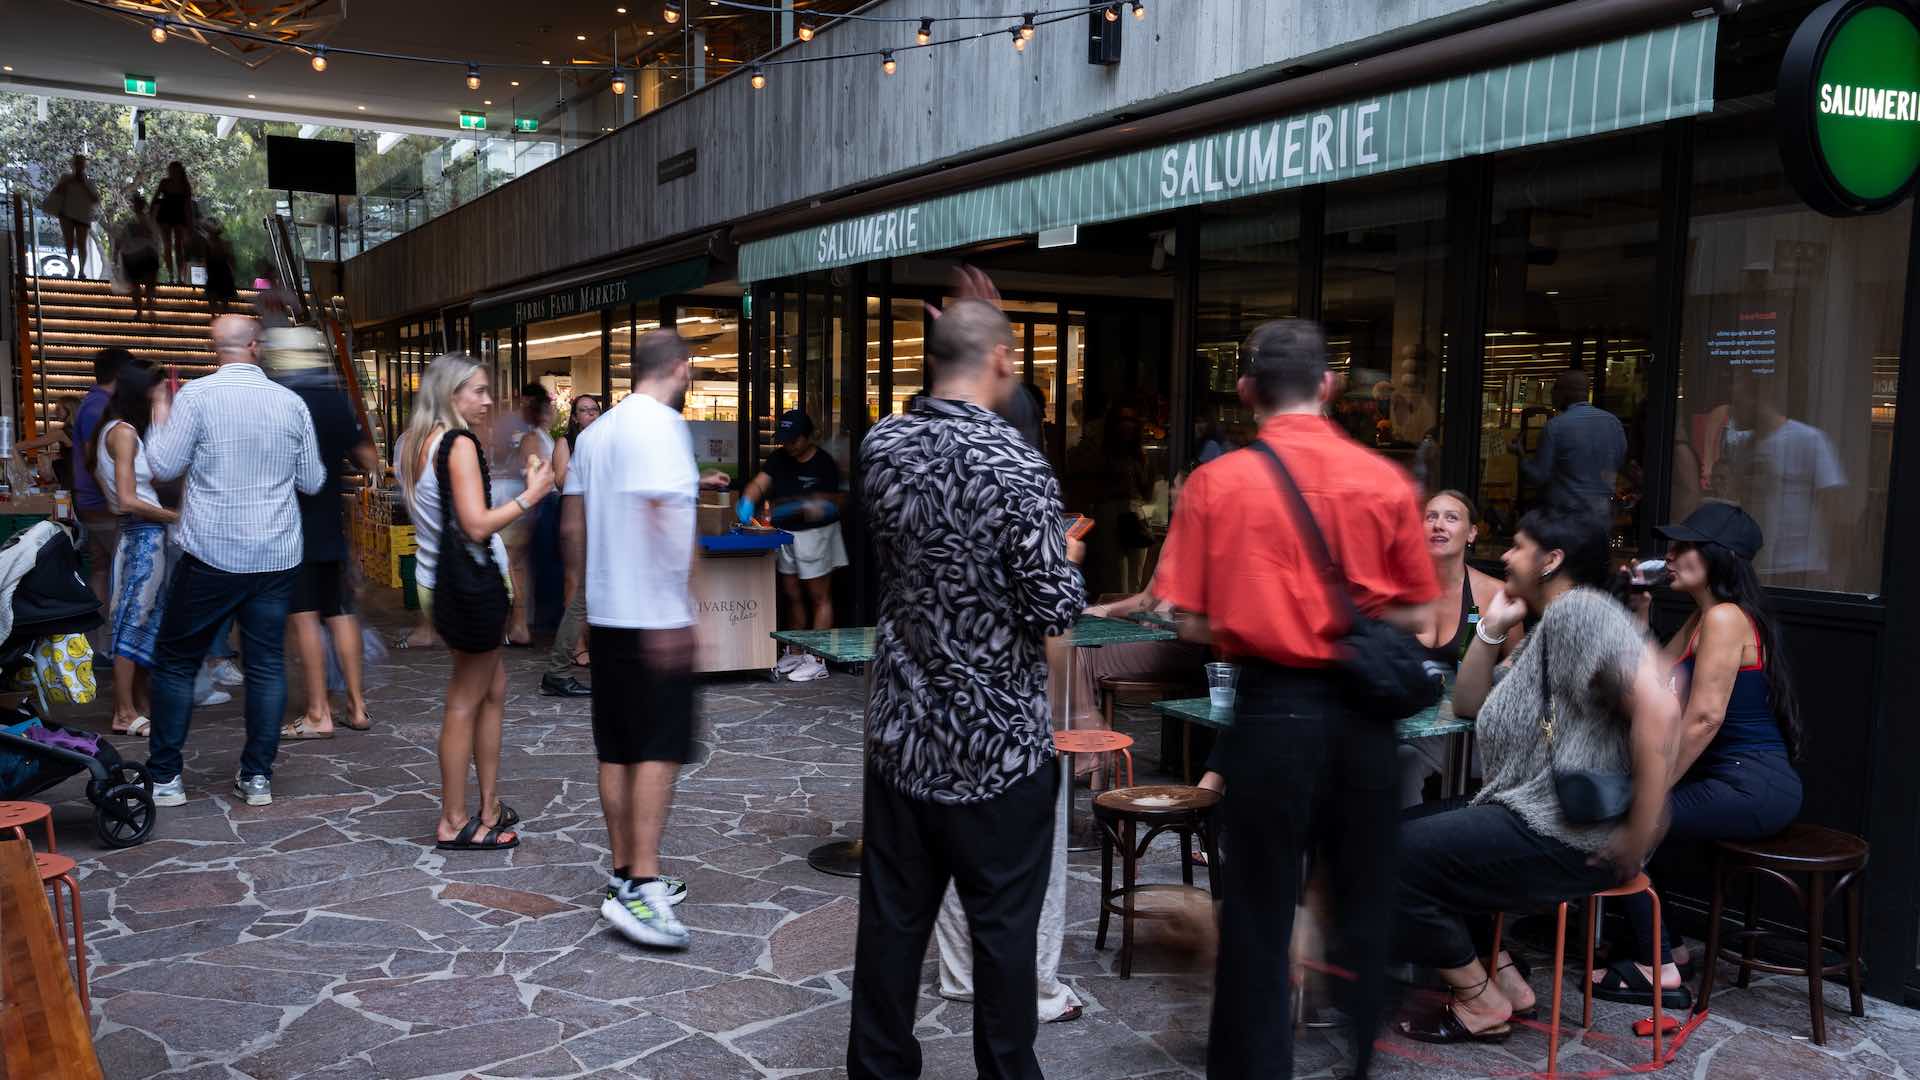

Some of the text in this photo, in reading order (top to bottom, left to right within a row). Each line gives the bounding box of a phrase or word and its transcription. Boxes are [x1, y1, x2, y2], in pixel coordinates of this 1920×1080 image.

[1820, 83, 1920, 121] SALUMERI
[1161, 103, 1380, 198] SALUMERIE
[818, 208, 919, 263] SALUMERIE
[515, 280, 626, 324] HARRIS FARM MARKETS
[698, 600, 758, 612] IVARENO
